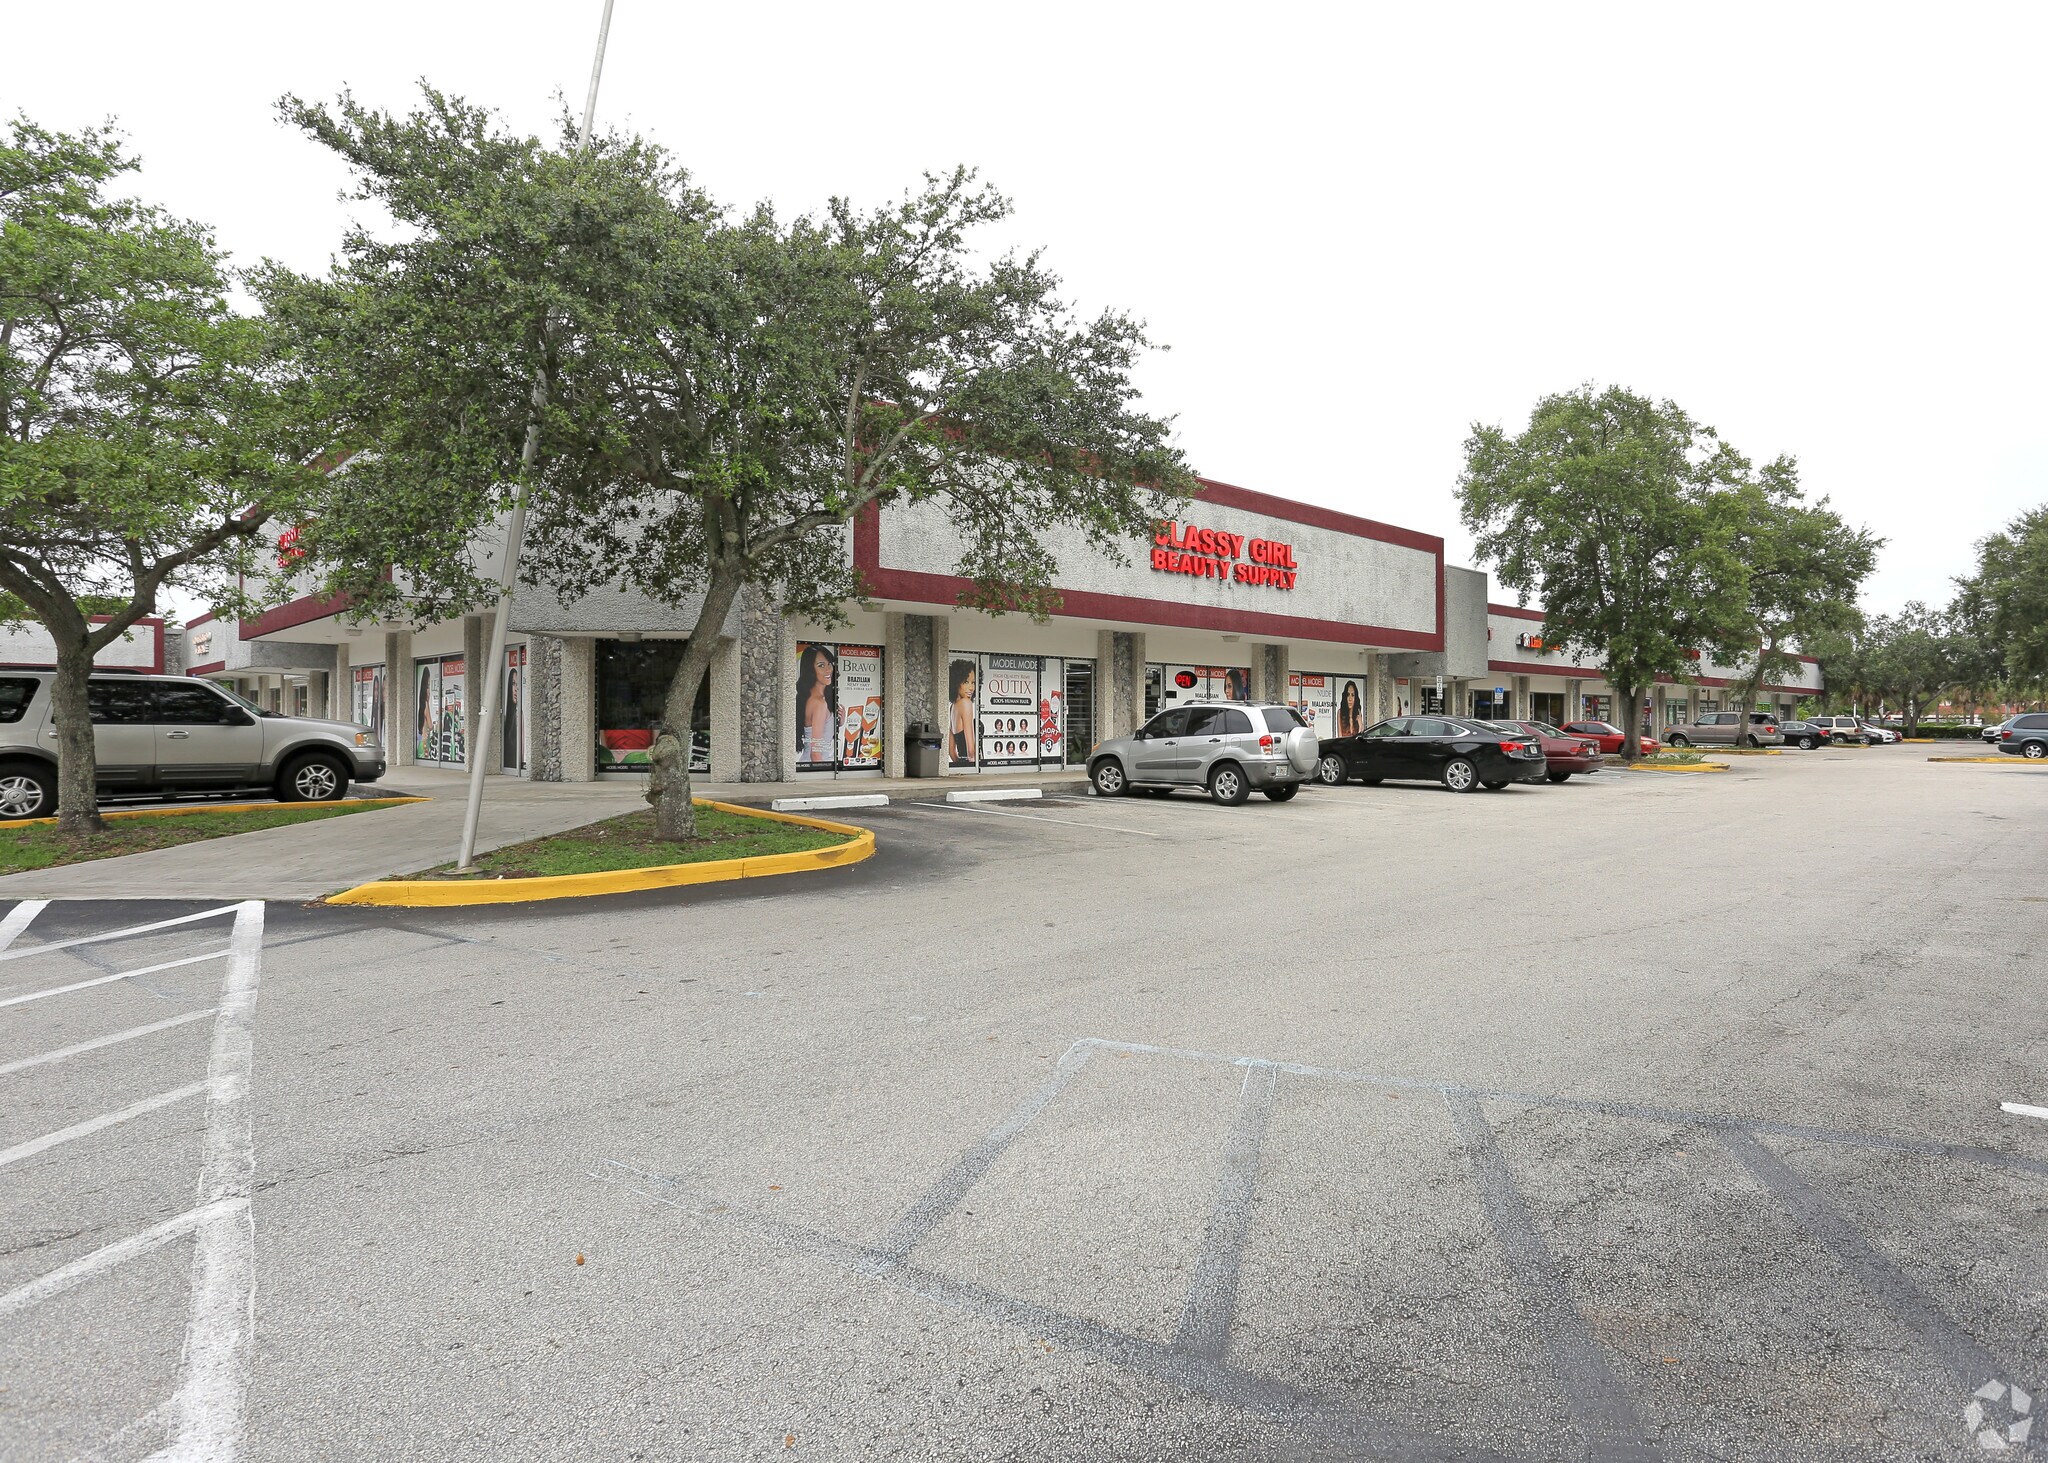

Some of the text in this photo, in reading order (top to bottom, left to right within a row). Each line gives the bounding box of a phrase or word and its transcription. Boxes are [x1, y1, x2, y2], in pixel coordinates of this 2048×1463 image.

[1248, 537, 1298, 569] GIRL
[1150, 548, 1298, 590] BEAUTY SUPPLY
[843, 660, 876, 673] BRAVO
[992, 659, 1043, 670] MODEL MODE
[989, 679, 1032, 697] QUTIX
[1291, 677, 1307, 686] MOEL
[1046, 740, 1052, 750] 3
